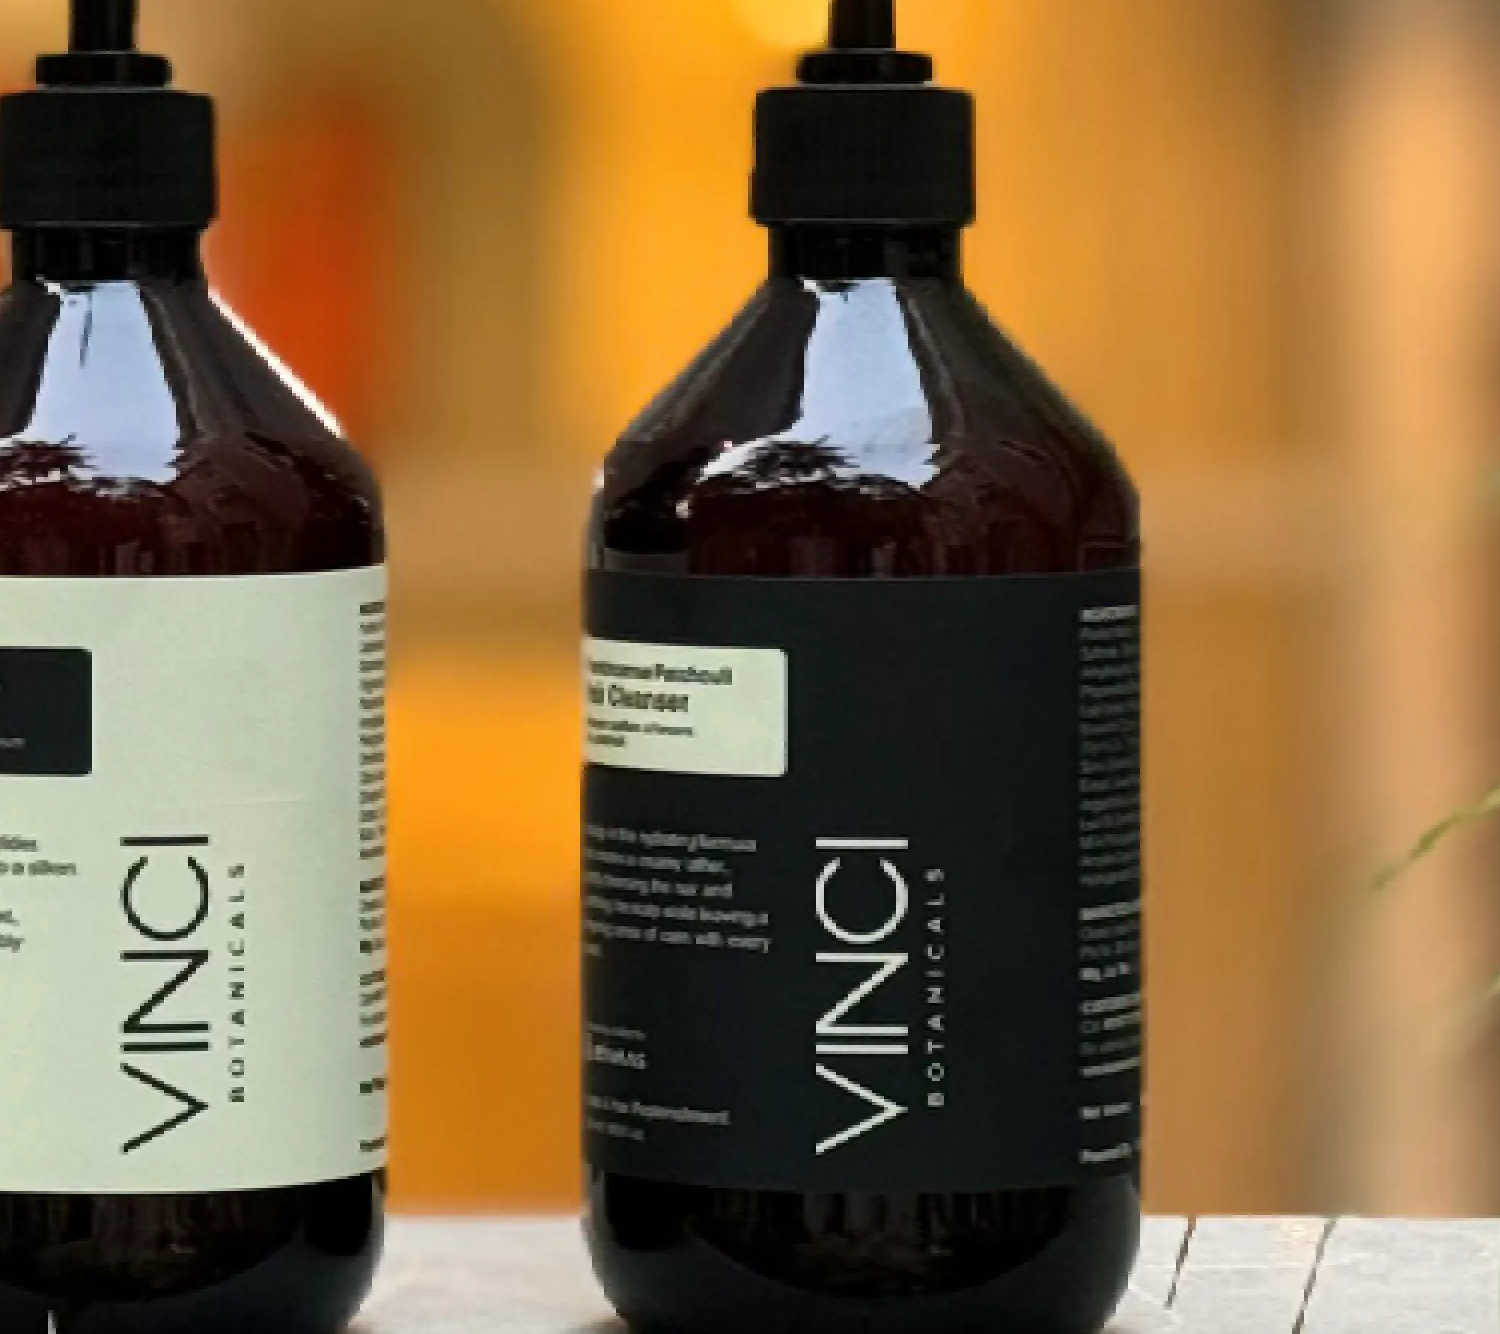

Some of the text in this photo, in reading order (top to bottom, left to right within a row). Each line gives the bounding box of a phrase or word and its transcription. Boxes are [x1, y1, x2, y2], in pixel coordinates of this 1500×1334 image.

[119, 833, 209, 1154] VINCI
[229, 863, 246, 1104] BOTANICALS
[815, 837, 909, 1155] VINCI
[927, 867, 945, 1108] BOTANICALS
